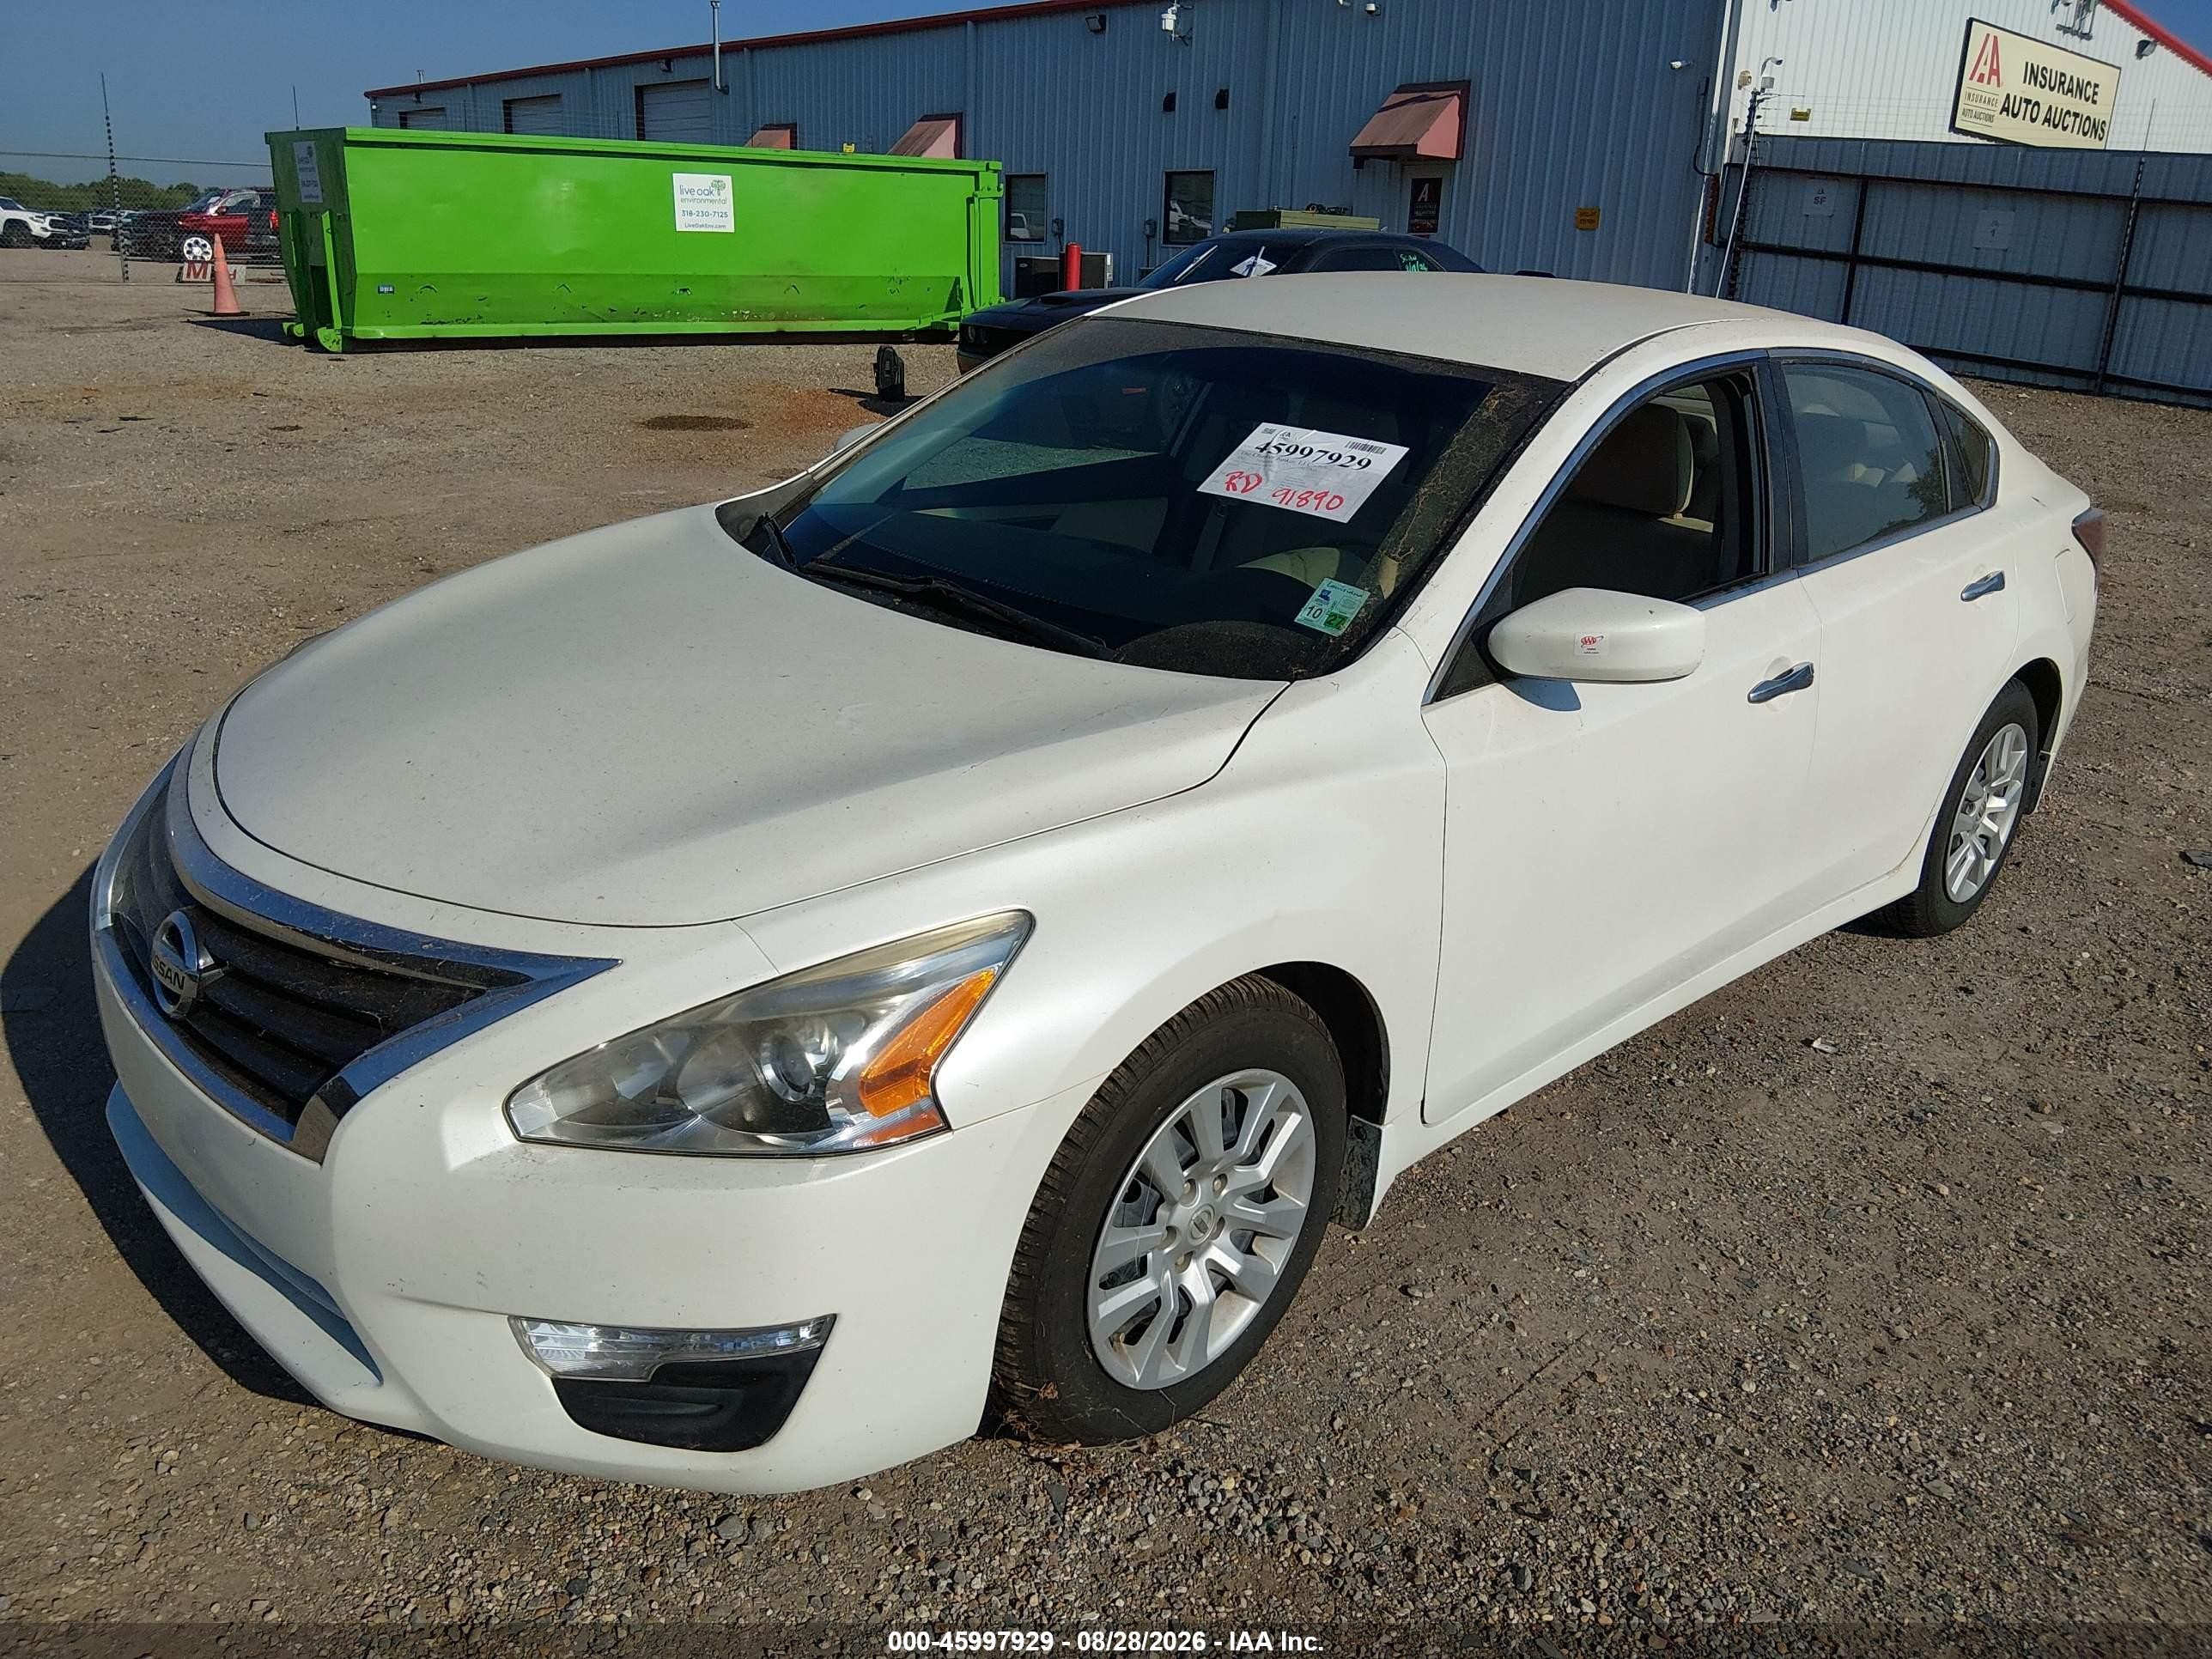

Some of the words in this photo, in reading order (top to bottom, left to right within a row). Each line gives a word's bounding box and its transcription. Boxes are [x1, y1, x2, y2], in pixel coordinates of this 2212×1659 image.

[2022, 61, 2100, 105] INSURANCE
[1964, 91, 1999, 108] INSURANCE
[1961, 108, 1973, 118] AUTO
[1973, 110, 1996, 124] AUCTIONS
[1999, 93, 2040, 124] AUTO
[2041, 104, 2107, 143] AUCTIONS
[679, 185, 696, 196] live
[696, 185, 715, 197] oak
[681, 210, 729, 218] 318-230-7125
[1255, 441, 1372, 471] 45997929
[1224, 471, 1263, 495] RD
[1271, 487, 1345, 512] 91890
[1306, 605, 1323, 619] 10
